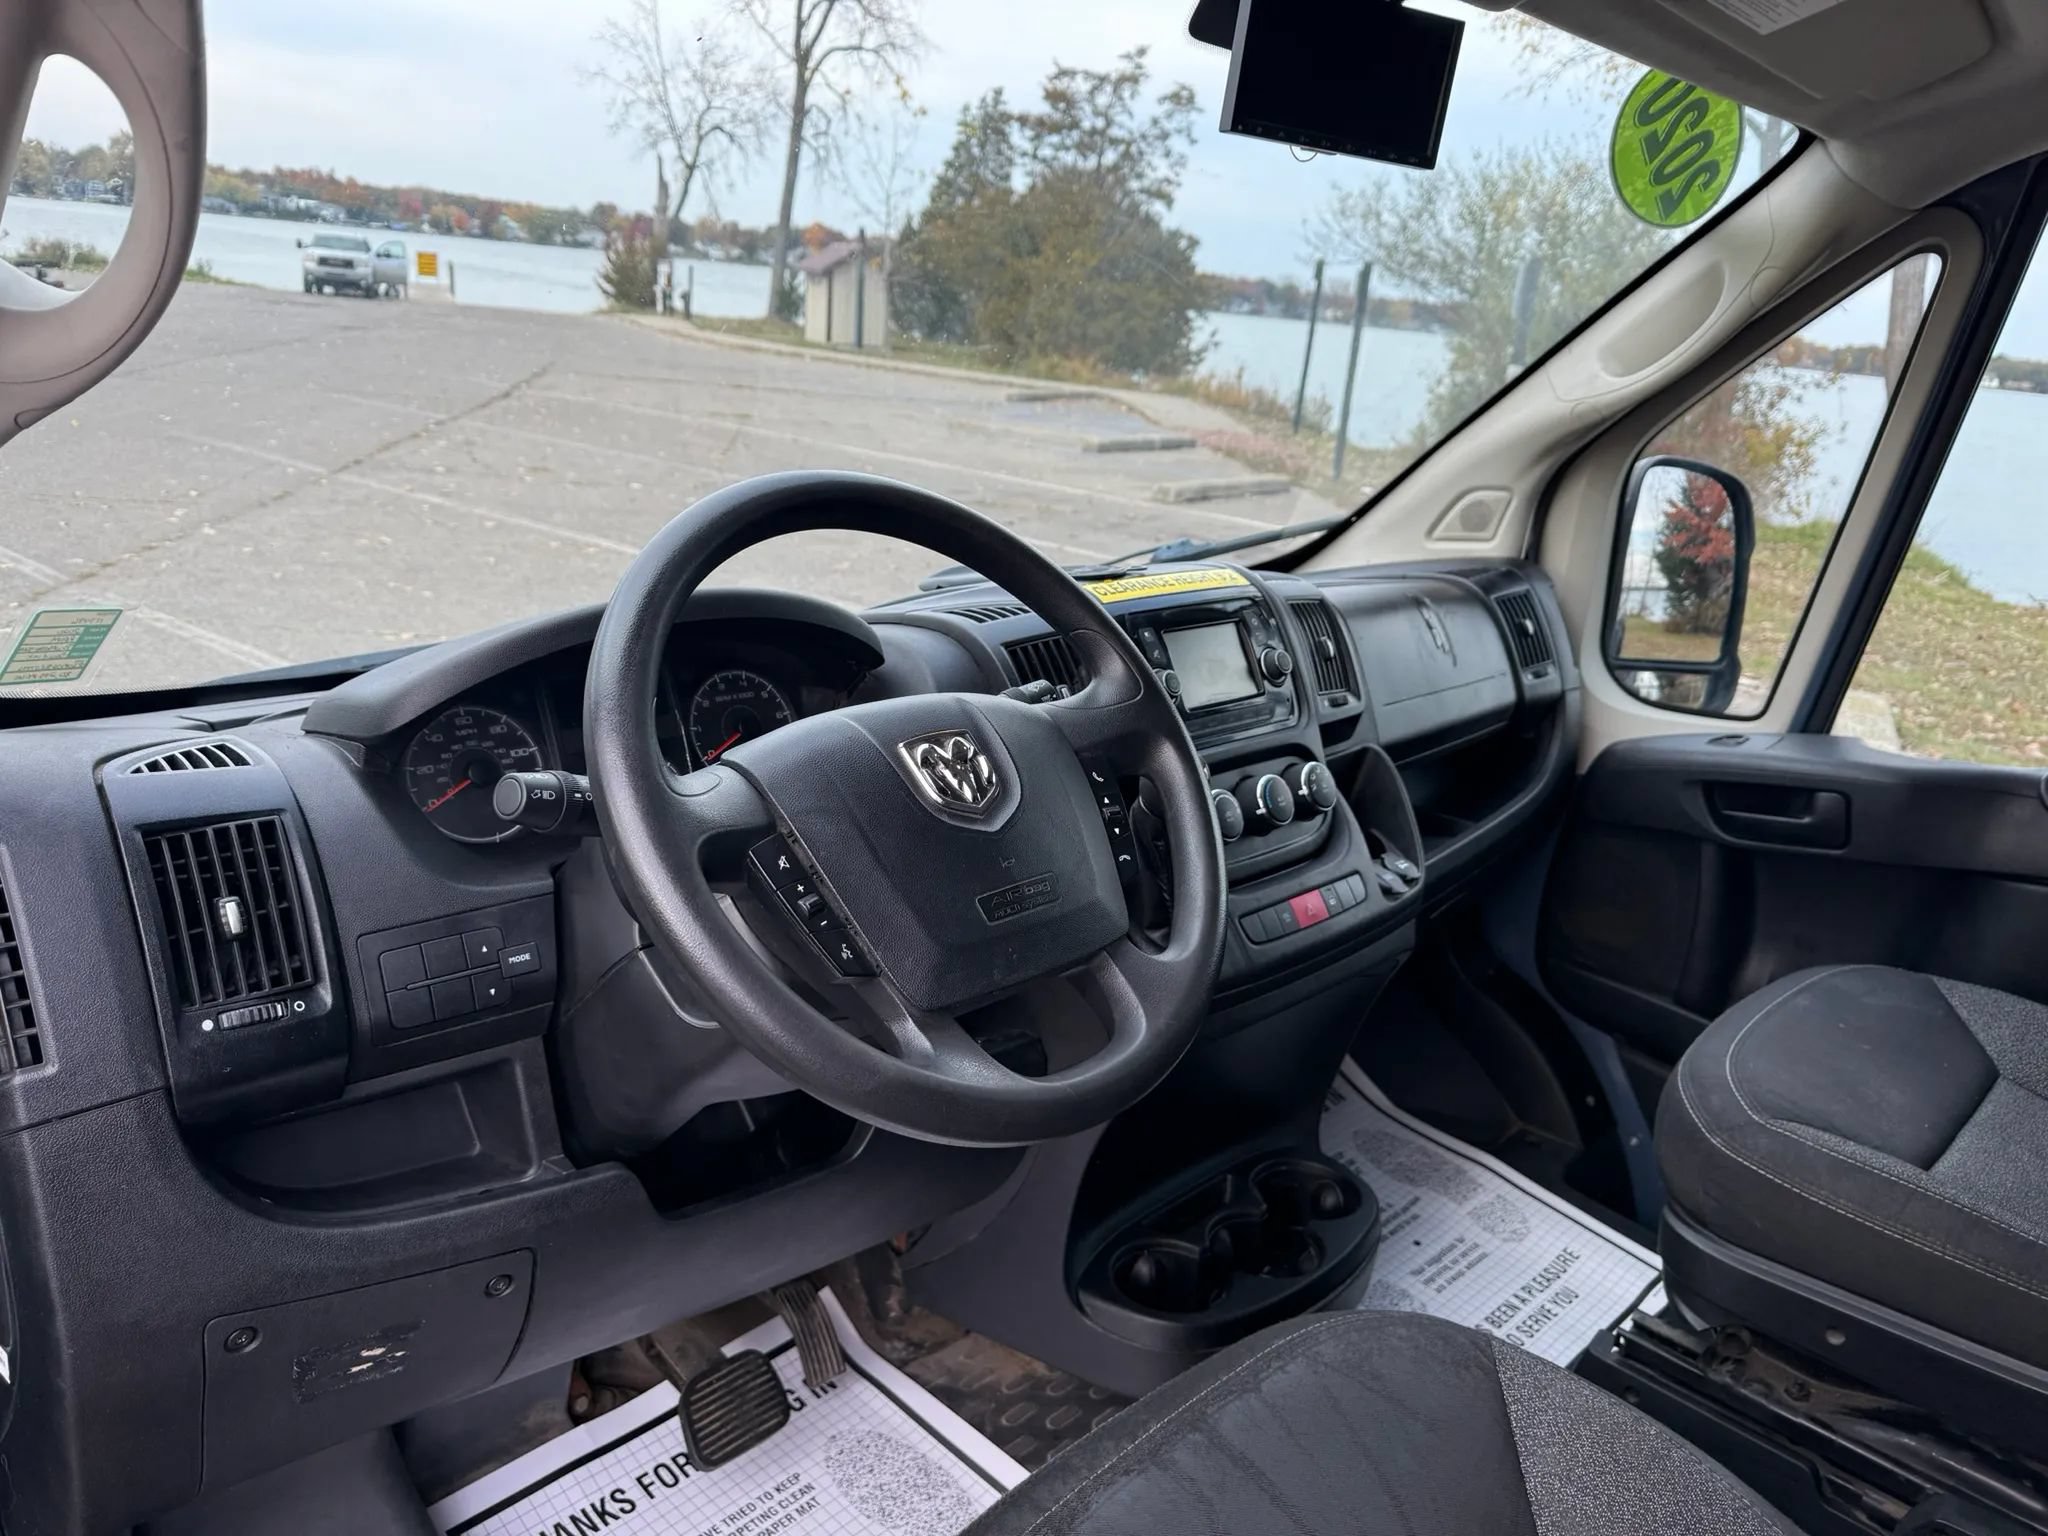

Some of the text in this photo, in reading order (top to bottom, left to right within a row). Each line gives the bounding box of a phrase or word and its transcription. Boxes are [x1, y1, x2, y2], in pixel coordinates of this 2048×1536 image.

[1092, 576, 1175, 596] CLEARANCE
[510, 747, 530, 757] 100
[416, 765, 434, 775] 20
[508, 952, 531, 964] MODE
[1520, 1246, 1582, 1299] PLEASURE
[1513, 1293, 1532, 1307] A
[1515, 1303, 1559, 1339] SERVE
[1547, 1285, 1580, 1309] YOU
[1484, 1299, 1522, 1329] BEEN
[635, 1451, 701, 1500] FOR
[720, 1501, 757, 1528] TRIED
[755, 1490, 774, 1505] TO
[773, 1471, 801, 1495] KEEP
[777, 1482, 816, 1510] CLEAN
[794, 1495, 821, 1518] MAT
